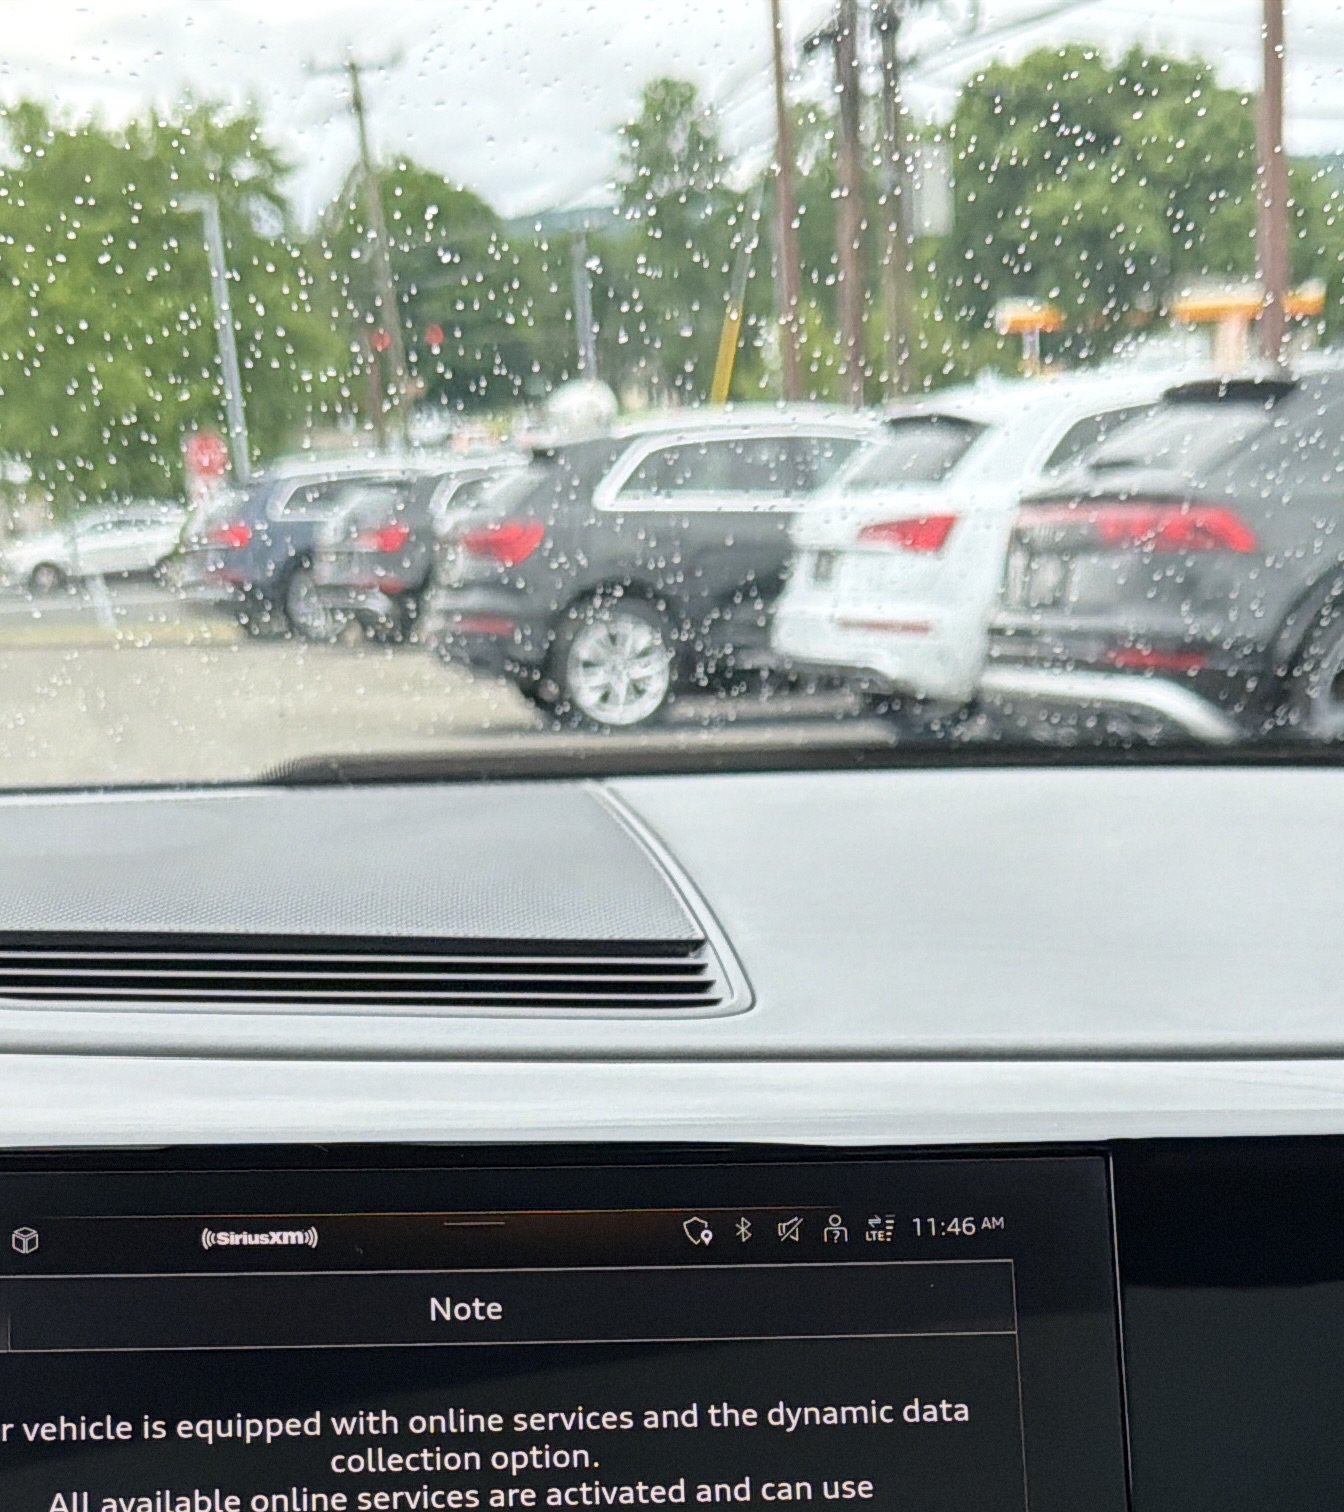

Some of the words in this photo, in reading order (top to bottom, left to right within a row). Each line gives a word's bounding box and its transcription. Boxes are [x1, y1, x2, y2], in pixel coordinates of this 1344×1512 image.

[865, 1230, 884, 1242] LTE
[913, 1217, 975, 1236] 11:46
[981, 1217, 1004, 1229] AM
[431, 1297, 502, 1321] Note
[23, 1415, 132, 1441] vehicle
[144, 1415, 166, 1439] is
[177, 1411, 320, 1444] equipped
[331, 1410, 398, 1435] with
[409, 1408, 503, 1433] online
[514, 1406, 633, 1431] services
[644, 1403, 697, 1428] and
[708, 1402, 757, 1427] the
[768, 1400, 893, 1432] dynamic
[903, 1398, 968, 1422] data
[331, 1447, 480, 1473] collection
[491, 1444, 599, 1476] option.
[251, 1487, 347, 1512] online
[358, 1485, 479, 1510] services
[490, 1489, 536, 1507] are
[547, 1478, 685, 1505] activated
[697, 1477, 750, 1502] and
[762, 1482, 812, 1500] can
[823, 1481, 873, 1499] use
